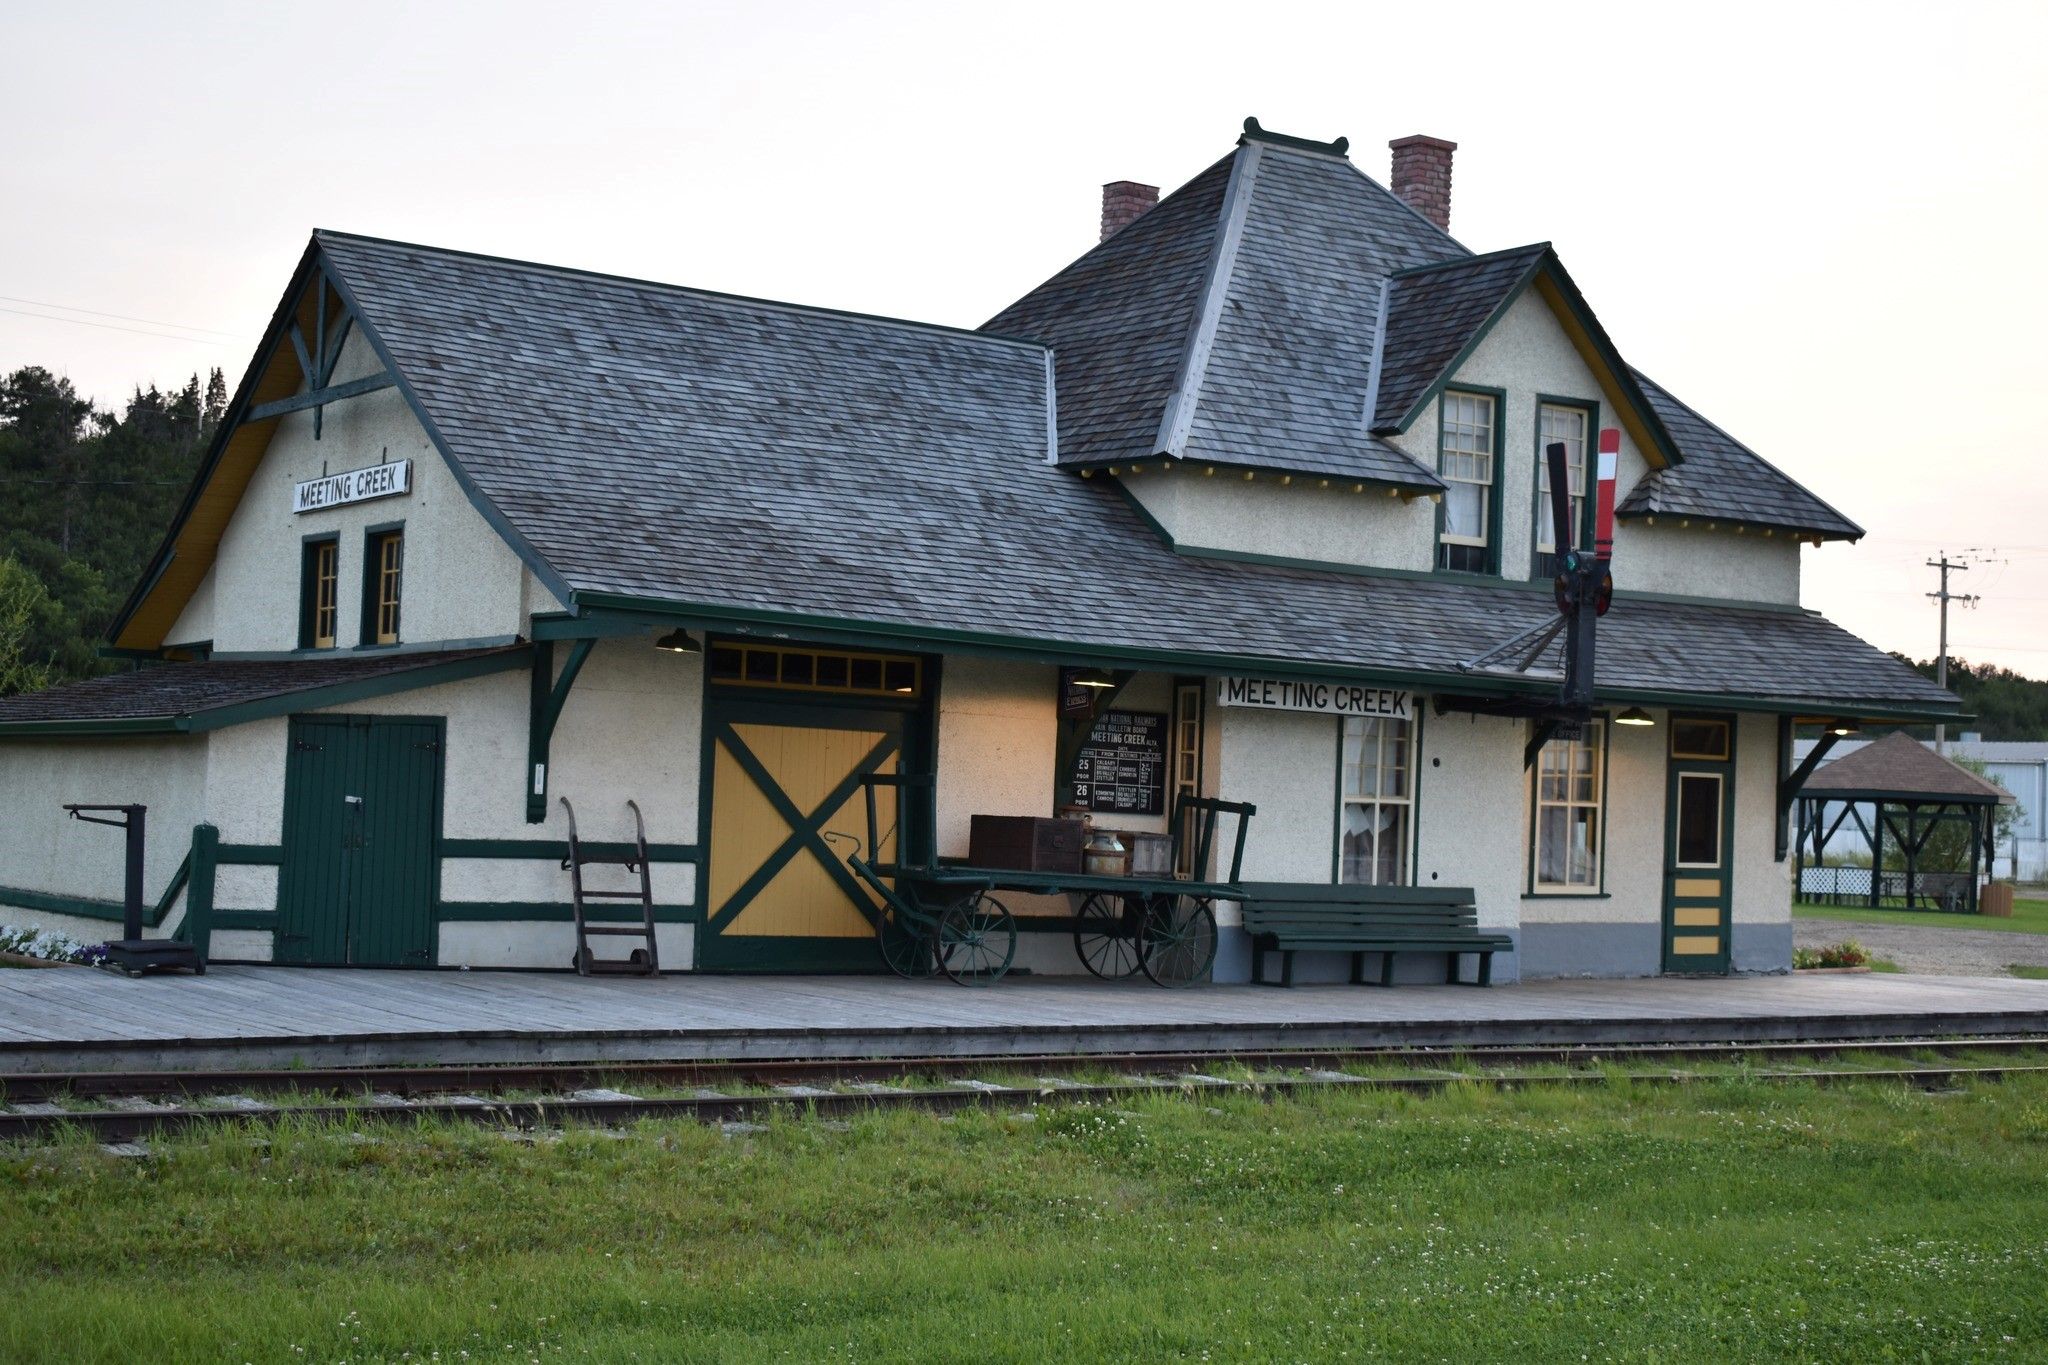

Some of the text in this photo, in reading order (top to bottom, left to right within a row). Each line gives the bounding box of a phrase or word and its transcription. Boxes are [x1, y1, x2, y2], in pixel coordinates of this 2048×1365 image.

[300, 466, 397, 508] MEETING CREEK
[1228, 677, 1407, 716] MEETING CREEK
[1110, 714, 1132, 725] NATIONAL
[1108, 725, 1131, 733] BULLETIN
[1132, 727, 1148, 735] BOARD
[1091, 731, 1122, 743] MEETING
[1124, 734, 1146, 745] CREEK
[1079, 759, 1089, 770] 25
[1077, 784, 1088, 796] 26
